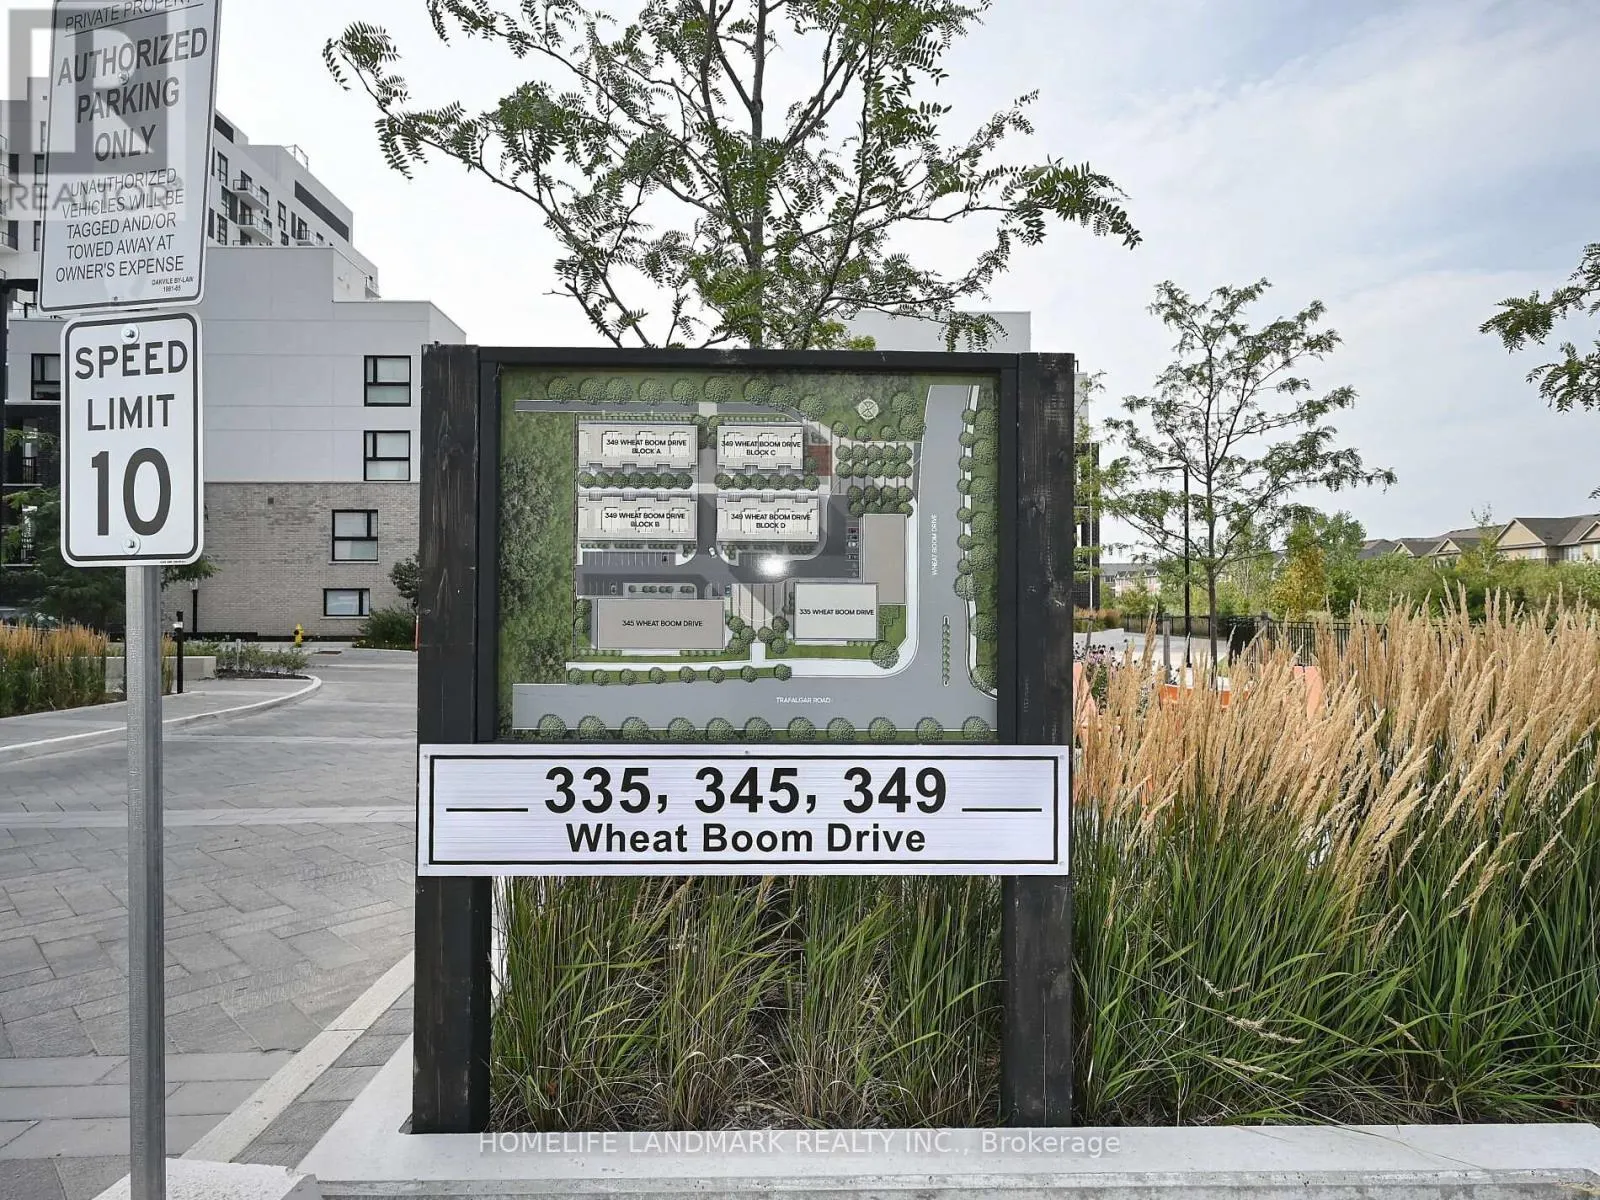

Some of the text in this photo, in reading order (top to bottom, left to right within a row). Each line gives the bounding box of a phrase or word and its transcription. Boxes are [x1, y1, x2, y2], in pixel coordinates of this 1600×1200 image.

[65, 4, 120, 32] PRIVATE
[57, 26, 208, 86] AUTHORIZED
[77, 76, 180, 123] PARKING
[94, 124, 157, 162] ONLY
[71, 167, 177, 198] UNAUTHORIZED
[62, 188, 185, 219] VEHICLES WILL BE
[67, 211, 177, 239] TAGGED AND/OR
[67, 234, 175, 260] TOWED AWAY AT
[55, 255, 185, 282] OWNER'S EXPENSE
[75, 340, 188, 380] SPEED
[87, 394, 175, 431] LIMIT
[91, 447, 172, 536] 10
[544, 766, 947, 815] 335, 345, 349
[566, 823, 926, 853] Wheat Boom Drive
